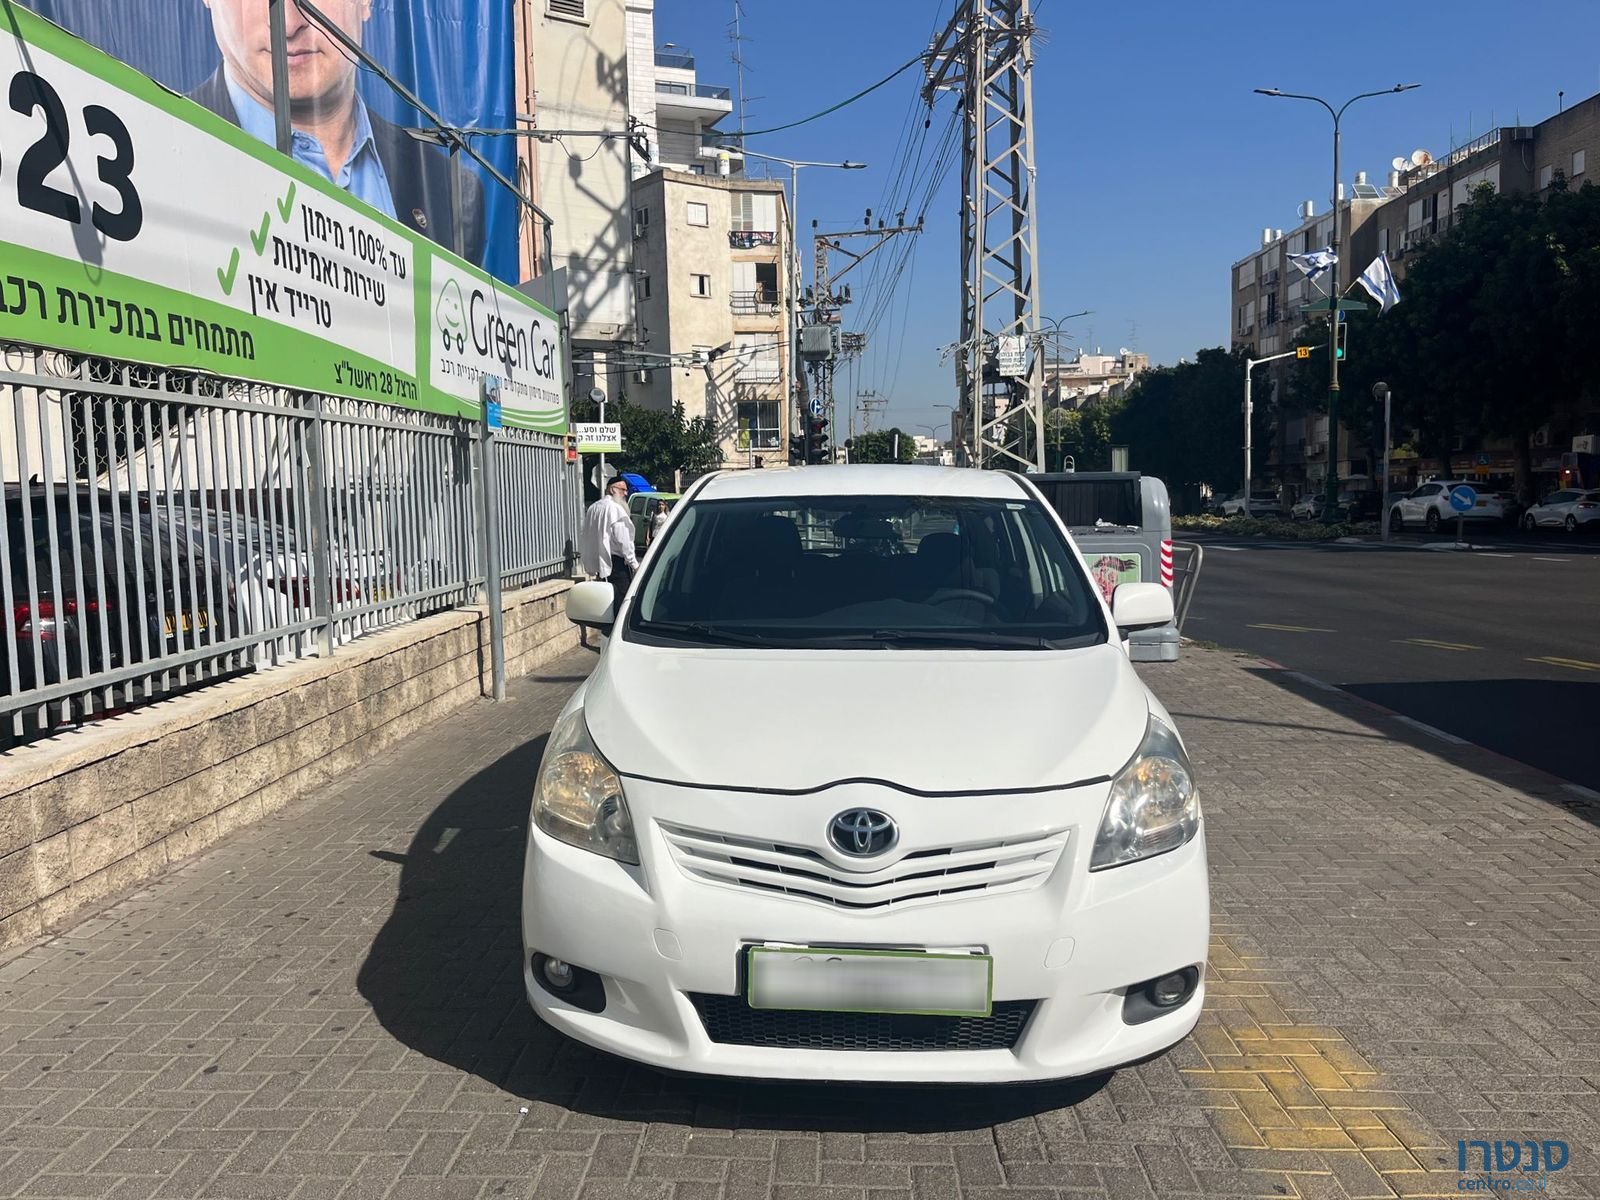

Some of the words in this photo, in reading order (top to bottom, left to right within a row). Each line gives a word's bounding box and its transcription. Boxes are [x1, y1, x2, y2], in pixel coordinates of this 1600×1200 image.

[0, 71, 143, 242] 23
[301, 204, 345, 250] מימון
[349, 225, 388, 271] 100%
[272, 235, 340, 290] ואמינות
[390, 250, 407, 280] עד
[247, 273, 280, 316] אין
[284, 286, 332, 329] טרייד
[343, 266, 386, 307] שירות
[56, 286, 162, 342] במכירת
[470, 289, 529, 372] Green
[530, 319, 556, 380] Car
[167, 312, 255, 361] מתמחים
[333, 360, 378, 392] ראשל"צ
[380, 371, 393, 395] 28
[394, 373, 418, 401] הרצל
[441, 358, 455, 376] רכב
[457, 363, 479, 384] לקניית
[577, 434, 583, 442] ק
